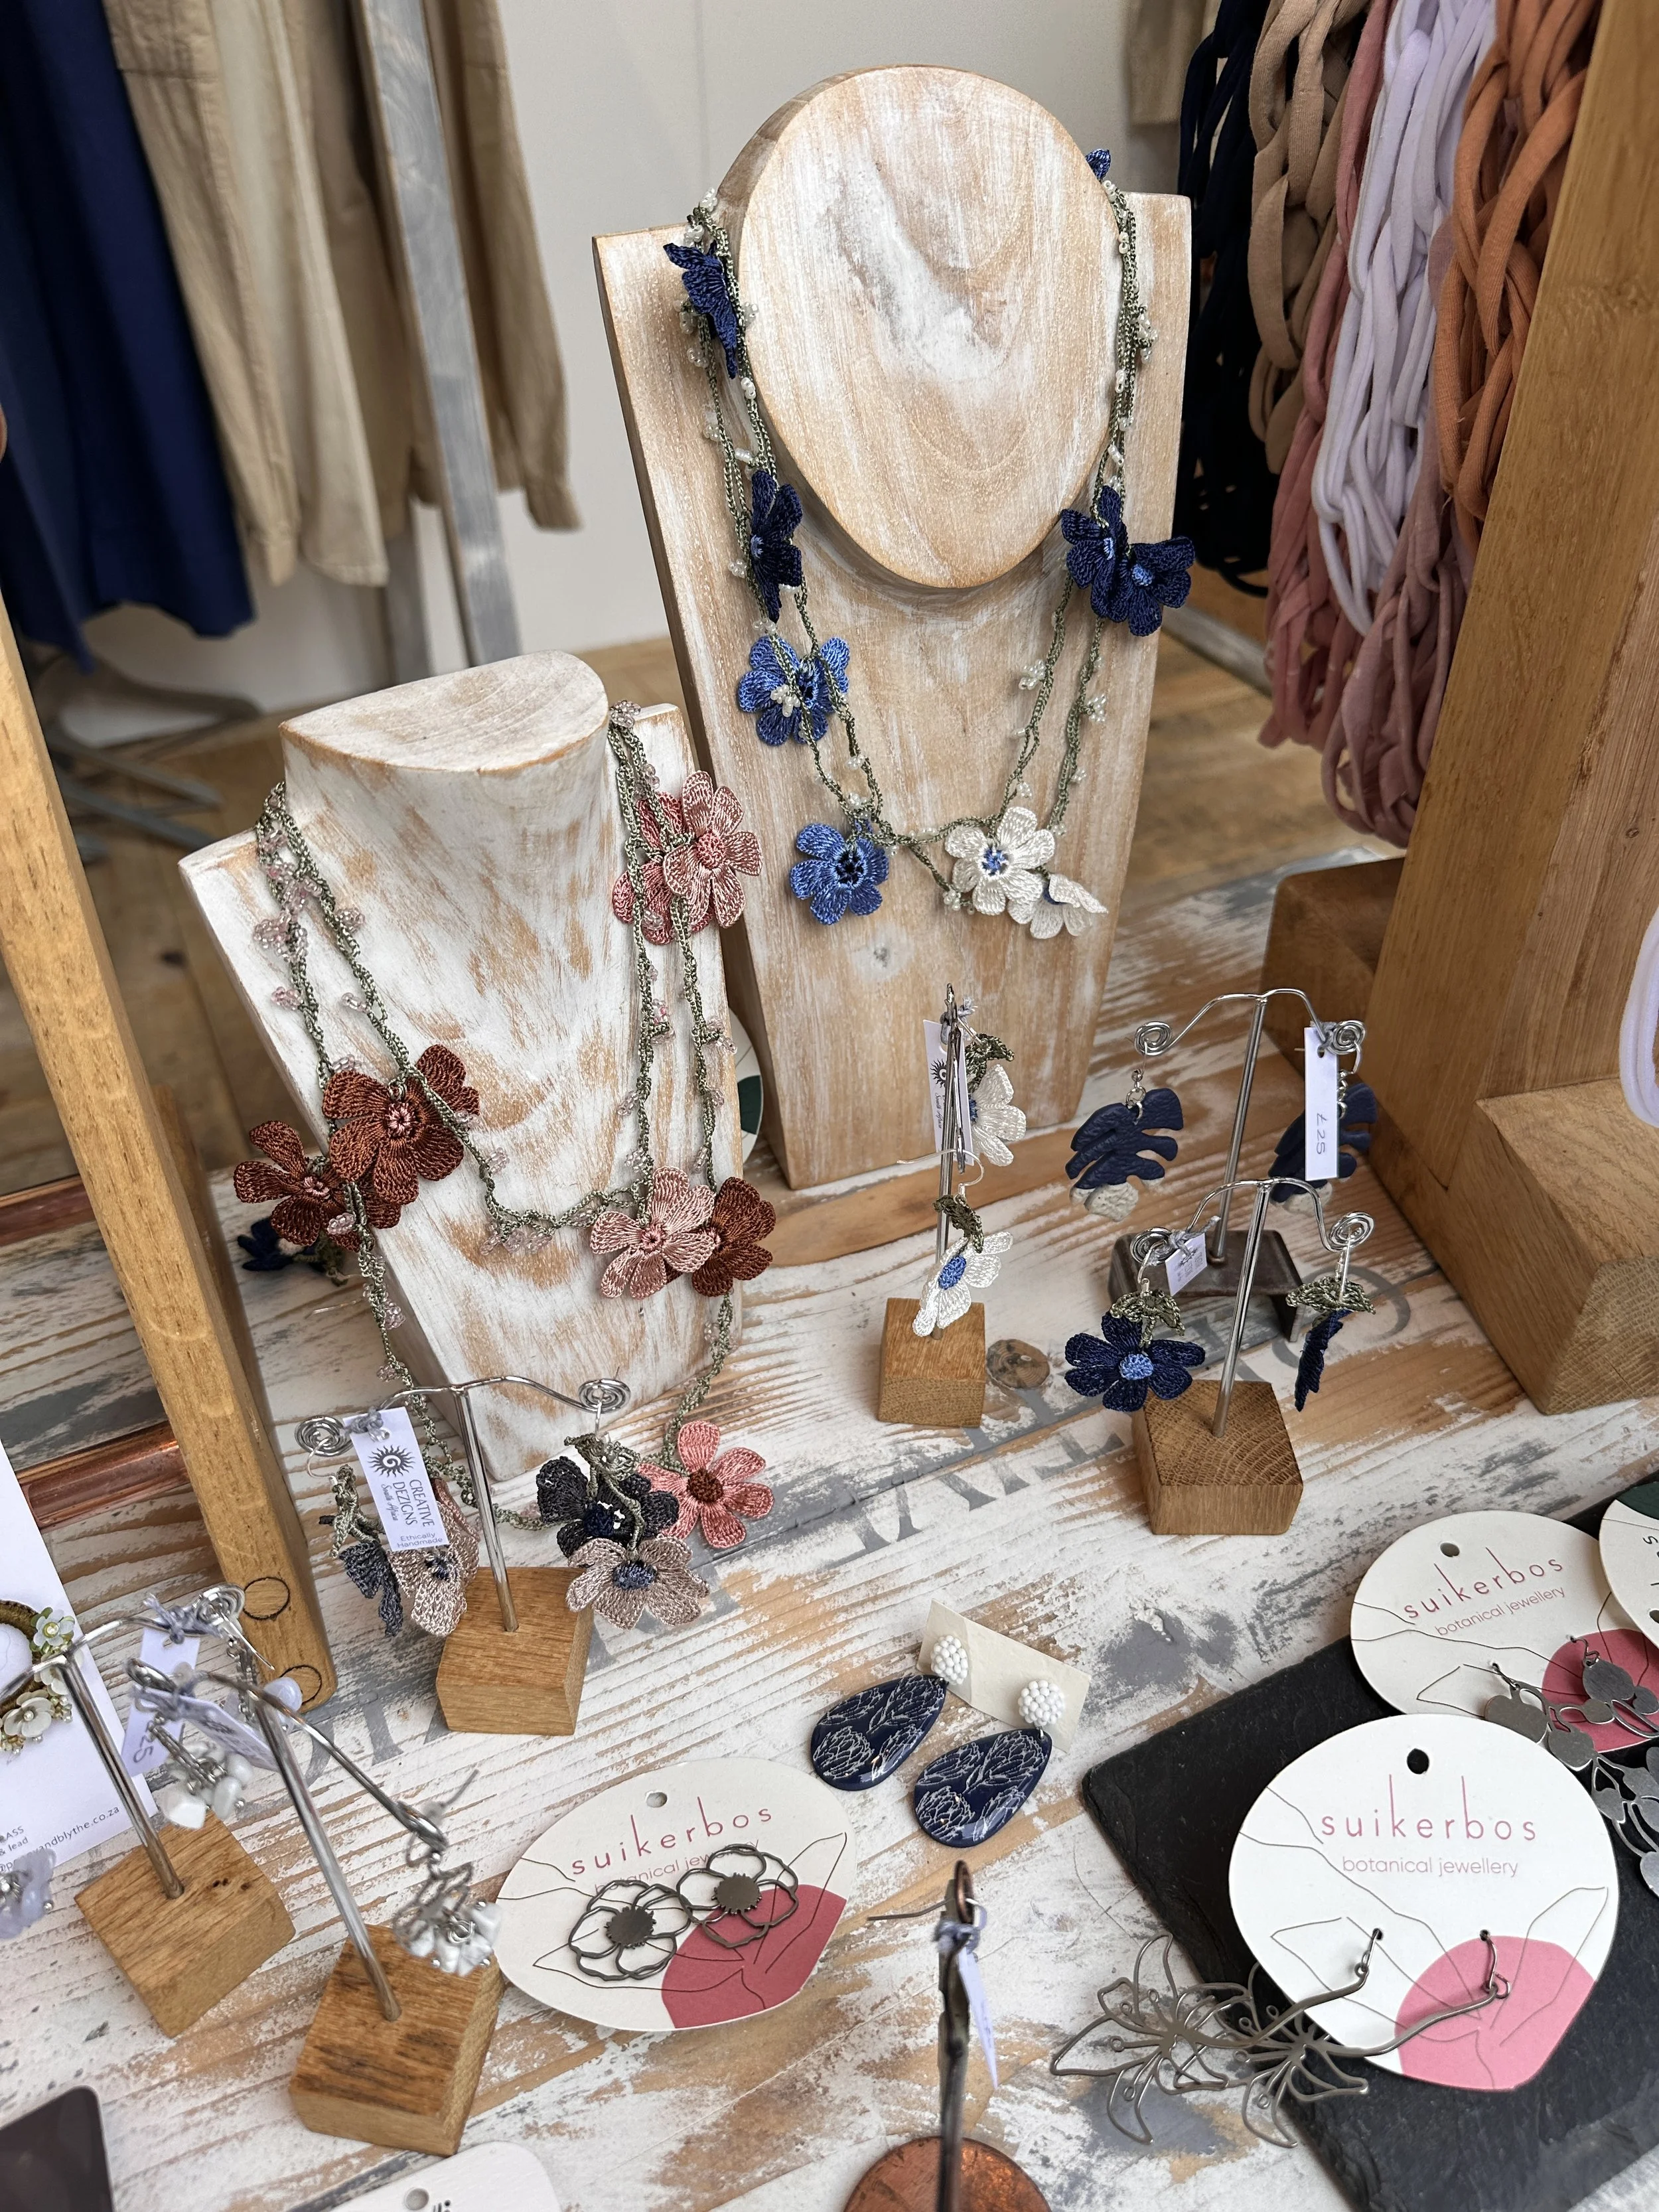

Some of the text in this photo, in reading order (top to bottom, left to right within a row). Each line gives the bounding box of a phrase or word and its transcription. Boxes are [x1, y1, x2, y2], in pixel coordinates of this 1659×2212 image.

[381, 1483, 399, 1521] South Africa
[393, 1481, 417, 1526] DEZIGNS
[409, 1479, 435, 1527] CREATIVE
[397, 1537, 443, 1548] Handmade
[400, 1532, 436, 1542] Ethically
[1404, 1546, 1563, 1619] suikerbos
[1434, 1586, 1565, 1636] botanical jewellery
[1321, 1774, 1536, 1841] suikerbos
[8, 1836, 29, 1852] lead
[572, 1796, 772, 1875] suikerbos
[1342, 1856, 1519, 1878] botanical jewellery
